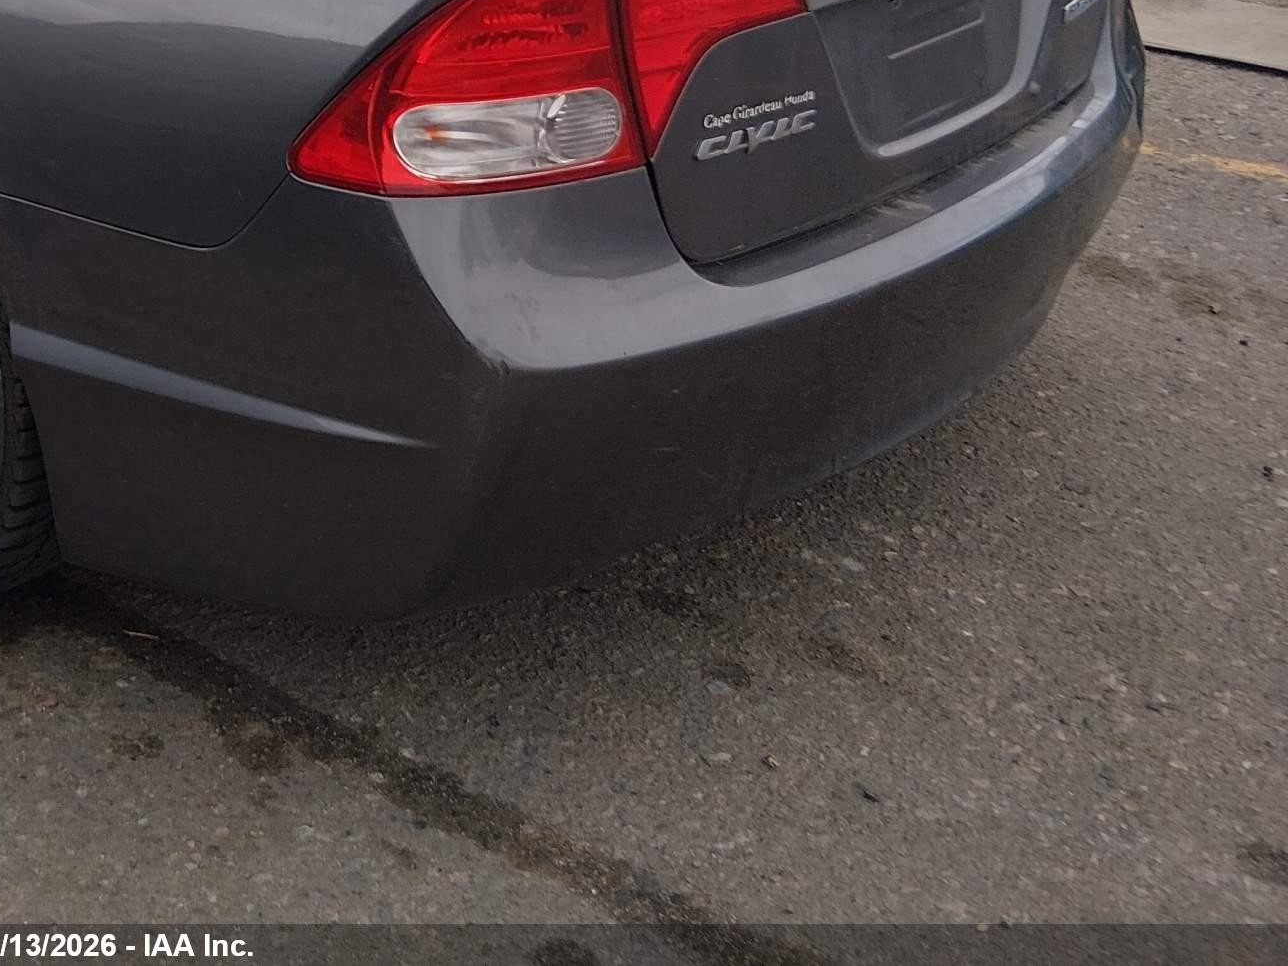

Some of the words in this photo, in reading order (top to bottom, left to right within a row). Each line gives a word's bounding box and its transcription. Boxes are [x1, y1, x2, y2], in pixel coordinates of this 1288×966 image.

[703, 113, 732, 129] Cape
[732, 103, 784, 121] Girardeau
[784, 90, 816, 105] Honda
[696, 109, 818, 161] CIVIC
